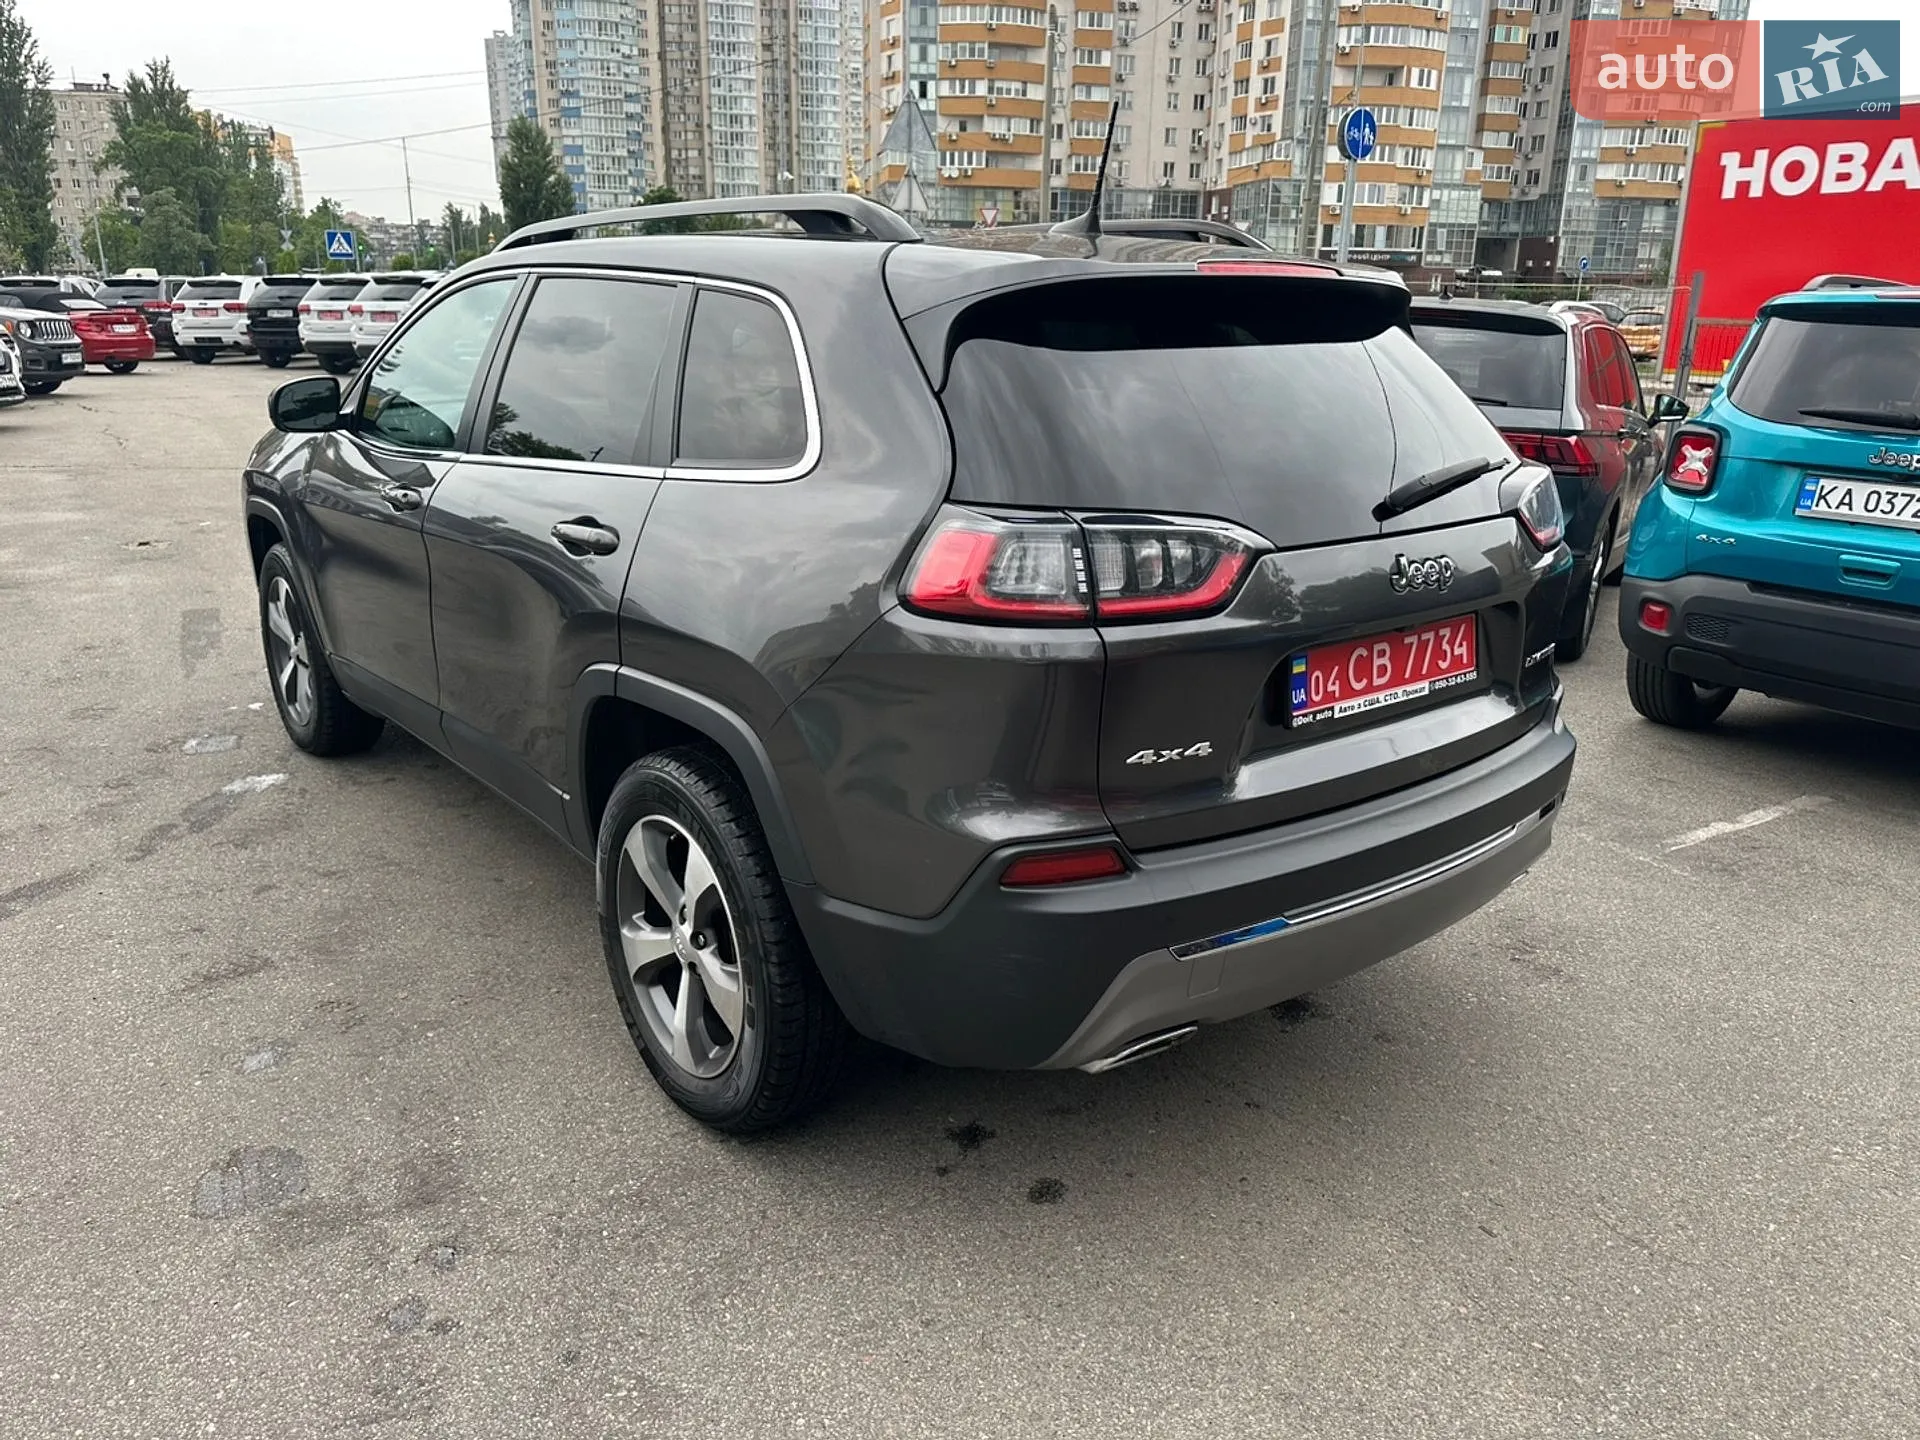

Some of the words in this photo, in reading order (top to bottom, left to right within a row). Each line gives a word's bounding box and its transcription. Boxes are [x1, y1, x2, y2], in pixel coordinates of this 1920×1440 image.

[1720, 137, 1920, 200] НОВА
[1815, 484, 1853, 512] KA
[1390, 553, 1456, 595] Jeep
[1292, 689, 1307, 704] UA
[1310, 665, 1340, 703] 04
[1348, 641, 1392, 691] CB
[1403, 623, 1468, 679] 7734
[1337, 703, 1356, 715] Авто
[1401, 686, 1426, 699] Прокат
[1126, 741, 1214, 765] 4x4
